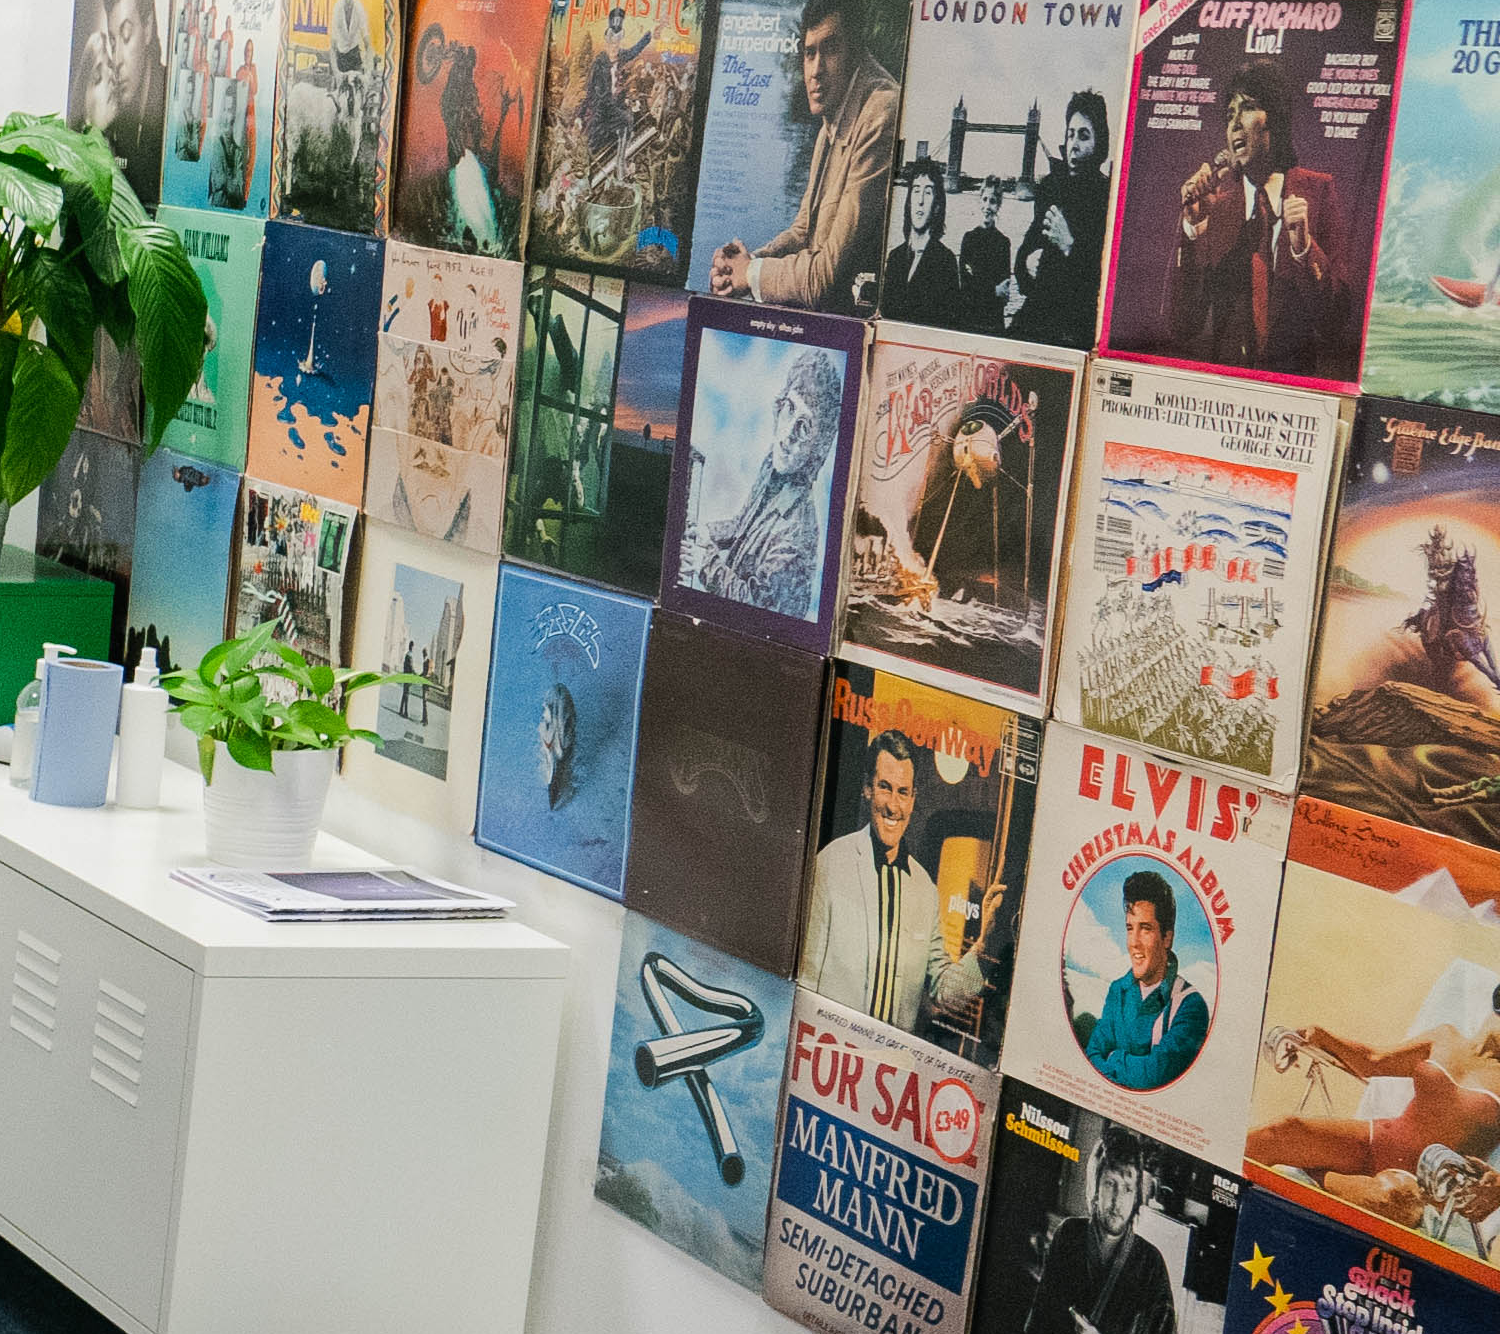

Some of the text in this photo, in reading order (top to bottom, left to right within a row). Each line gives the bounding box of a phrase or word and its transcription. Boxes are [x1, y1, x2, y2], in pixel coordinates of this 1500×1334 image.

[722, 11, 782, 34] engelbert
[1043, 1, 1123, 28] TOWN
[1198, 0, 1253, 29] CLIFF
[1252, 1, 1342, 32] RICHARD
[720, 31, 801, 55] humperdinck
[1244, 23, 1285, 55] Live!
[722, 54, 746, 75] The
[1451, 49, 1481, 75] 20
[722, 85, 761, 108] Waltz
[1341, 82, 1364, 96] ROCK
[1166, 410, 1242, 436] LIEUTENANT
[1277, 428, 1318, 449] SUITE
[1281, 411, 1320, 432] SUITE
[1220, 434, 1315, 465] GEORGE SZELL
[832, 676, 891, 734] Russ
[1061, 819, 1237, 947] CHRISTMAS ALBUM
[947, 892, 980, 922] plays
[789, 1019, 864, 1114] FOR
[1019, 1101, 1071, 1141] Nilsson
[1005, 1112, 1081, 1163] Schmilsson
[789, 1106, 964, 1228] MANFRED
[1212, 1173, 1240, 1196] RCA
[812, 1168, 925, 1262] MANN
[779, 1217, 945, 1328] SEMI-DETACHED
[1316, 1283, 1371, 1328] Step
[1345, 1266, 1416, 1318] Black
